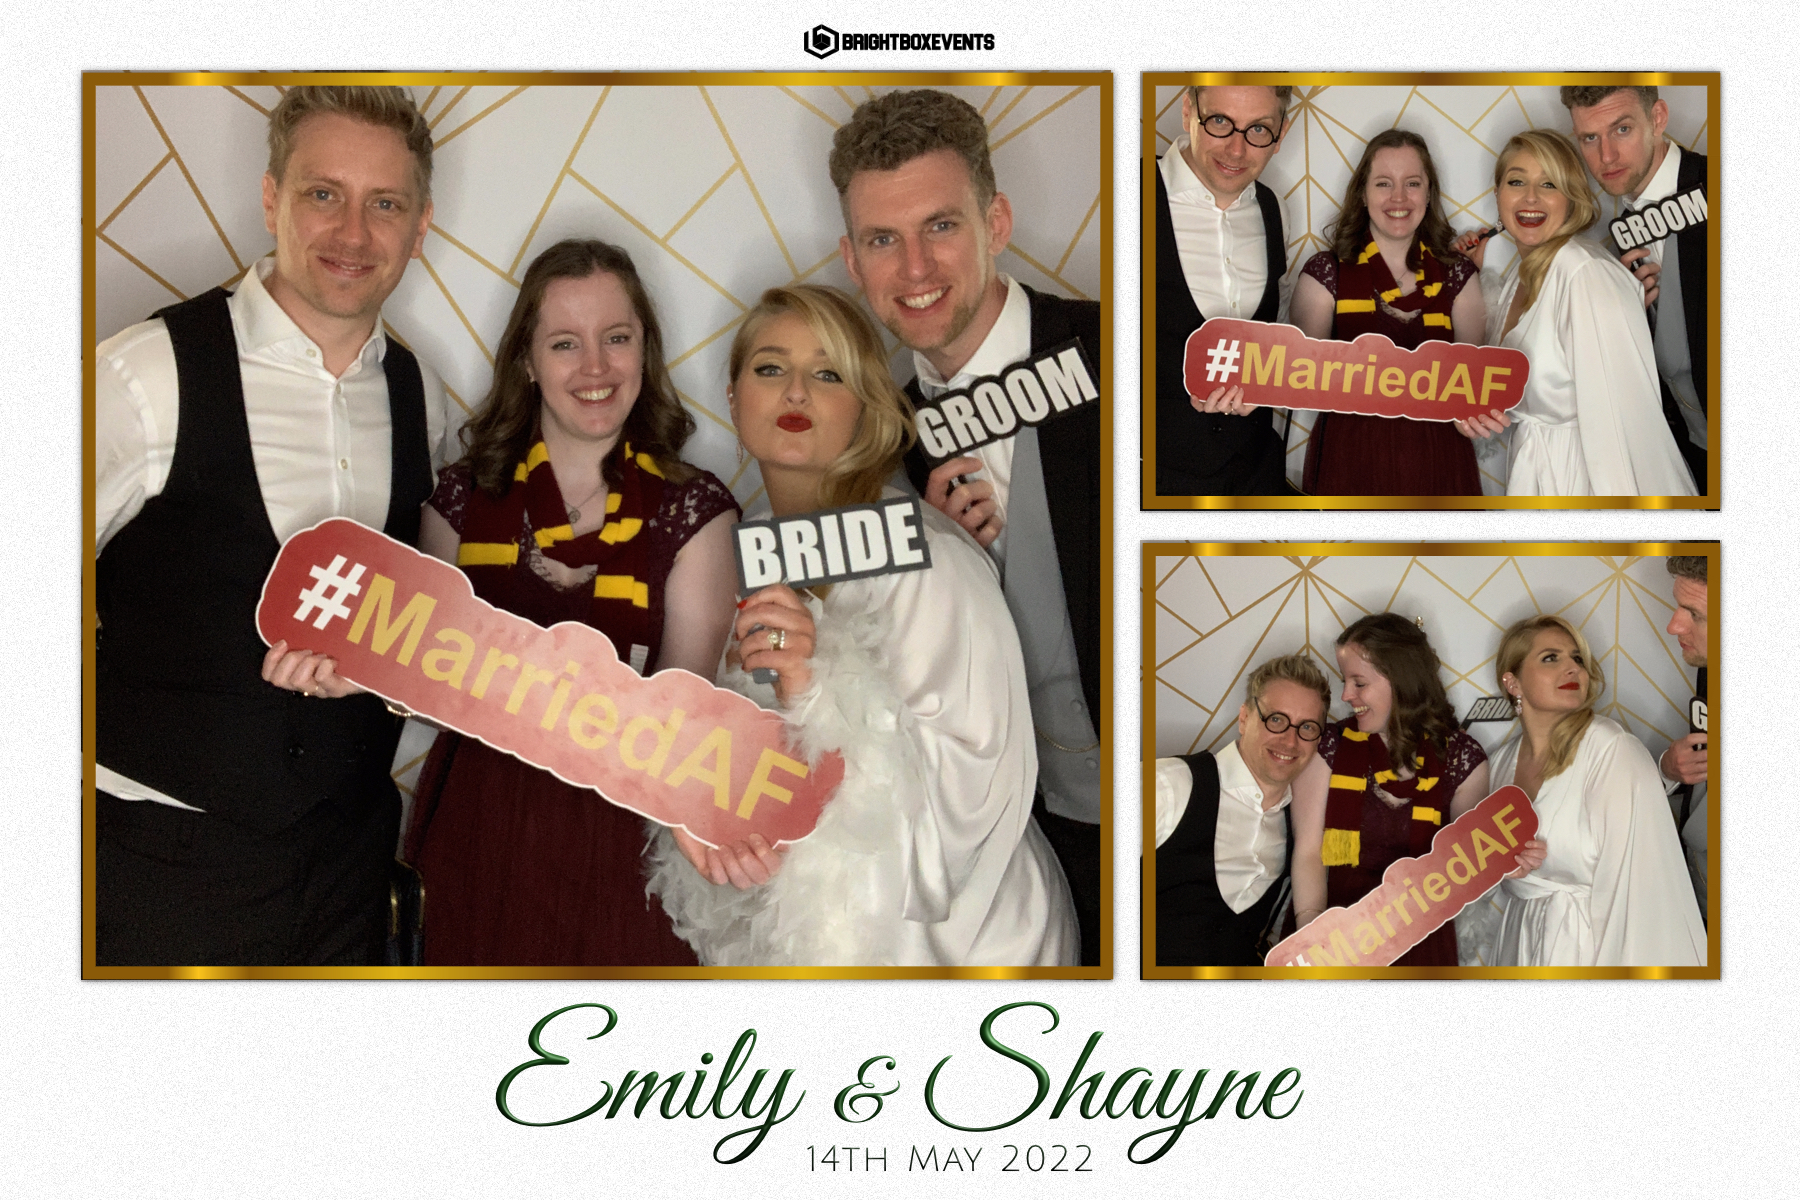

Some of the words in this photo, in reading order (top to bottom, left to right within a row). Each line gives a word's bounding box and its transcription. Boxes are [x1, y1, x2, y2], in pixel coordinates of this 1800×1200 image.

[1611, 188, 1708, 250] GROOM
[914, 346, 1100, 459] GROOM
[1205, 338, 1512, 406] #MarriedAF
[737, 501, 924, 589] BRIDE
[292, 554, 809, 821] #MarriedAF
